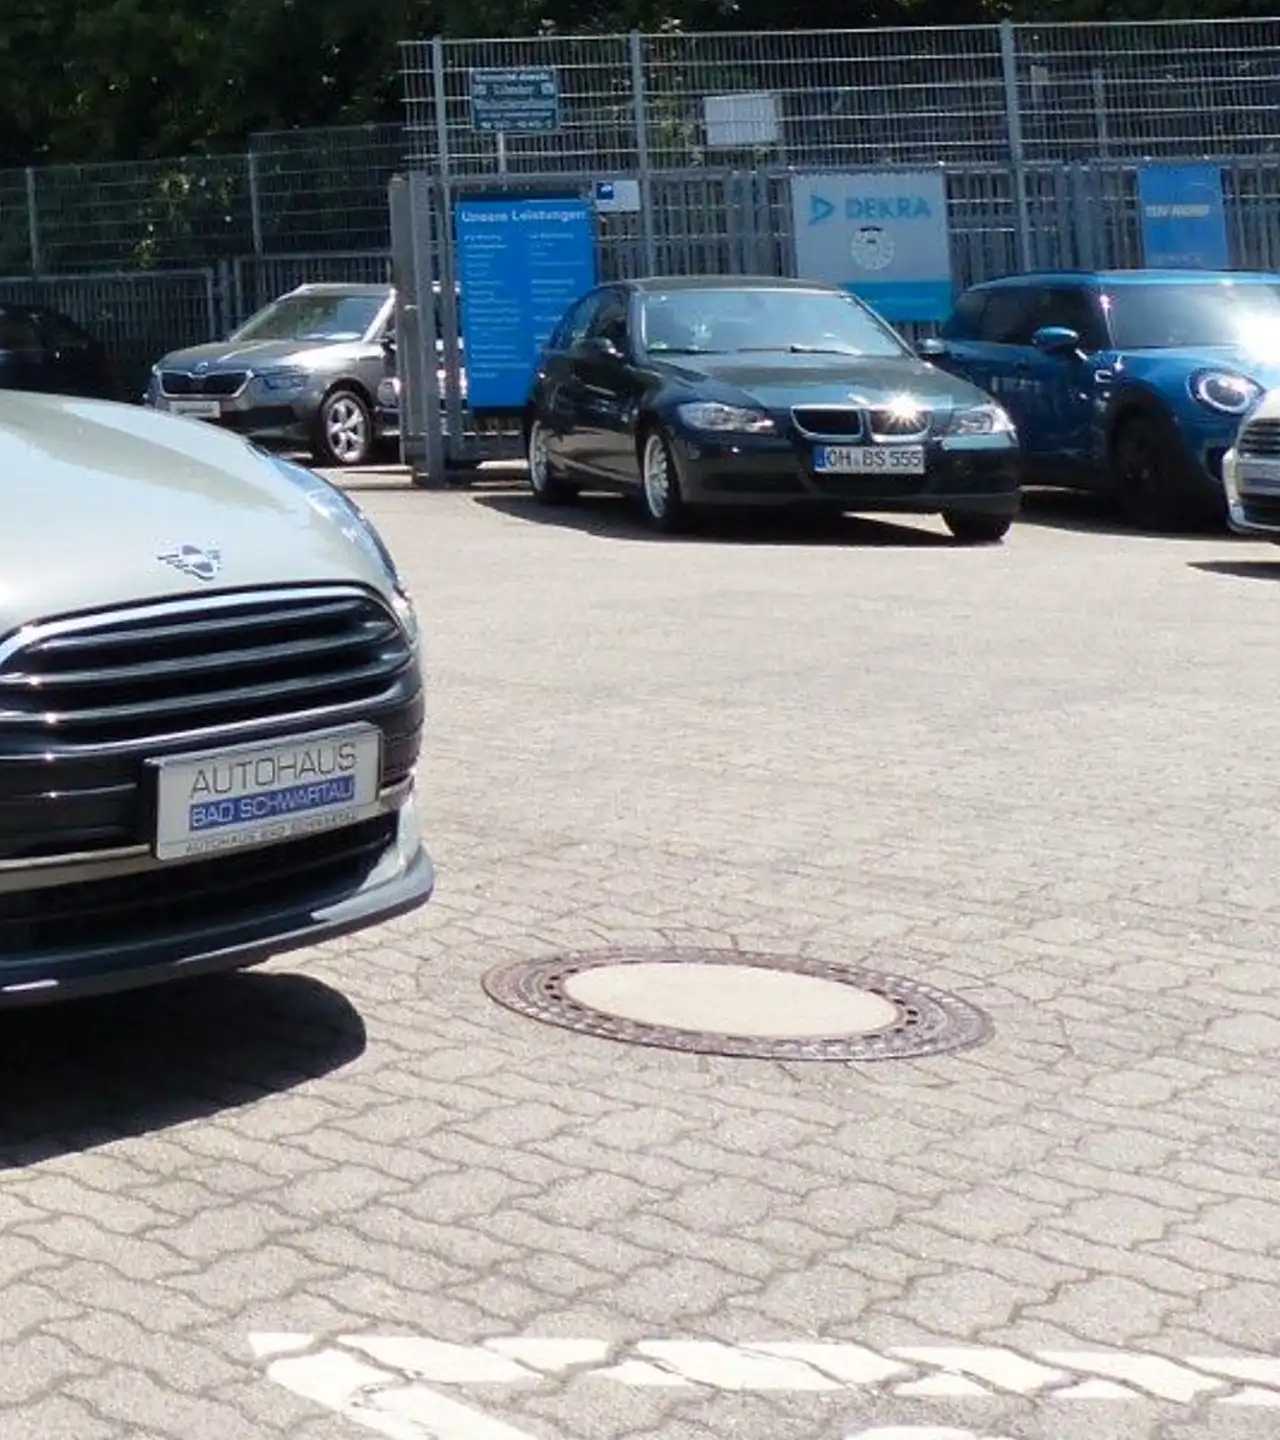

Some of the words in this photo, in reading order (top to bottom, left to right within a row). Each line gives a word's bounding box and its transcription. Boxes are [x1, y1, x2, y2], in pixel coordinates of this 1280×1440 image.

[511, 209, 587, 222] Leistungen
[845, 195, 932, 219] DEKRA
[828, 449, 852, 467] OH
[862, 449, 885, 467] BS
[889, 450, 921, 468] 555
[190, 742, 358, 798] AUTOHAUS
[191, 800, 234, 828] BAD
[239, 779, 354, 819] SCHWARTAU
